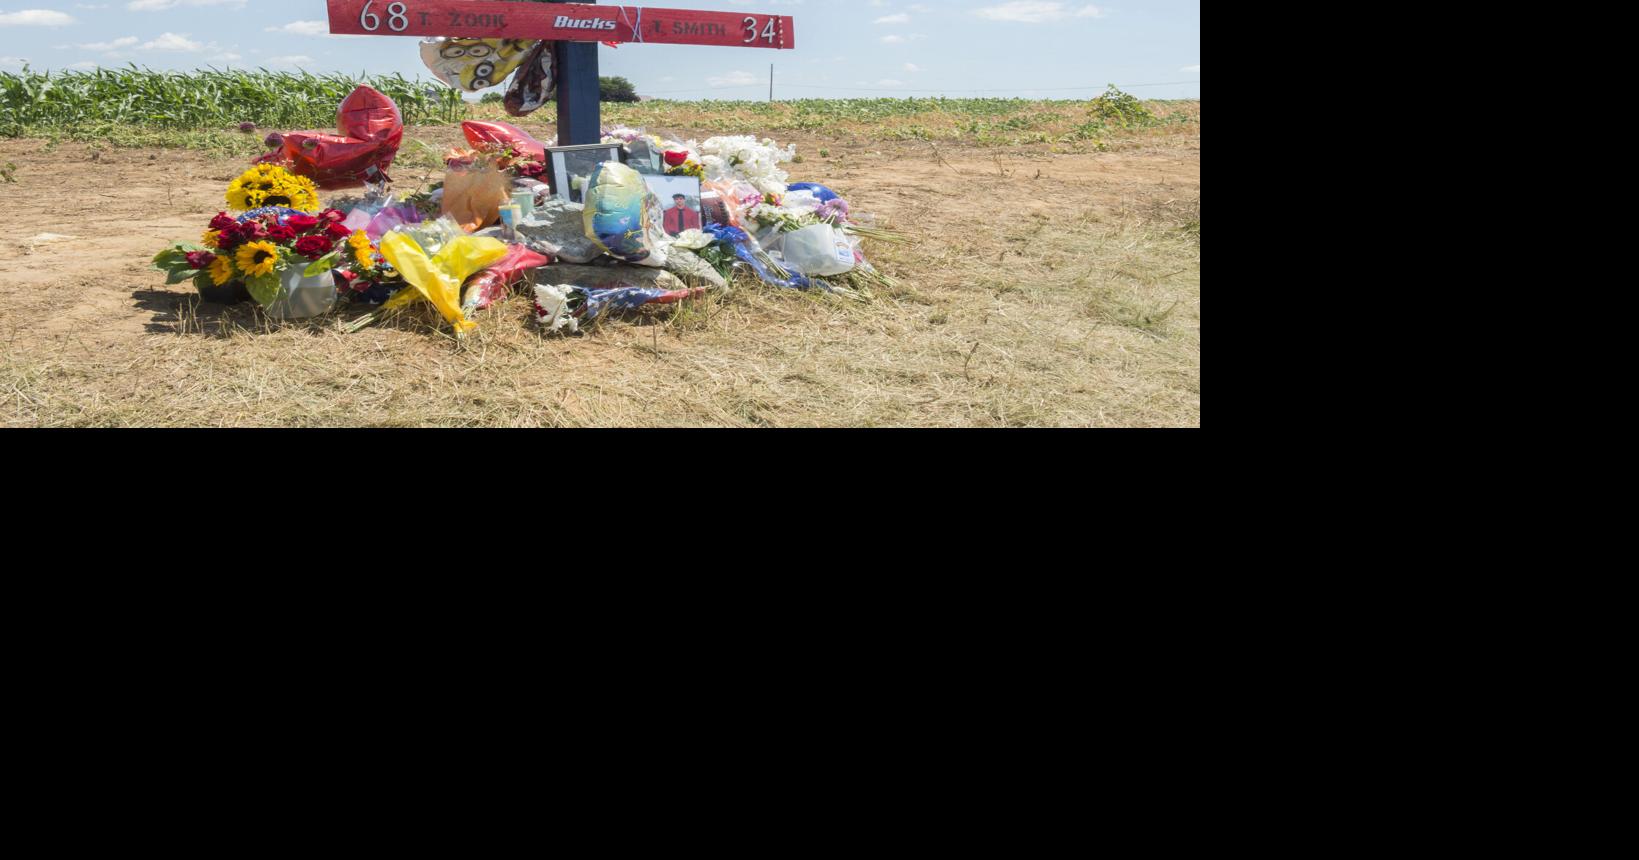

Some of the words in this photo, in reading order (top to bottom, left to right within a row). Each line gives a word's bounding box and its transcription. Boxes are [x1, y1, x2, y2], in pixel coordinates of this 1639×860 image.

[360, 0, 408, 31] 68
[448, 12, 506, 28] ZOOK
[553, 15, 616, 30] Bucks
[672, 20, 726, 36] SMITH
[743, 16, 776, 43] 34
